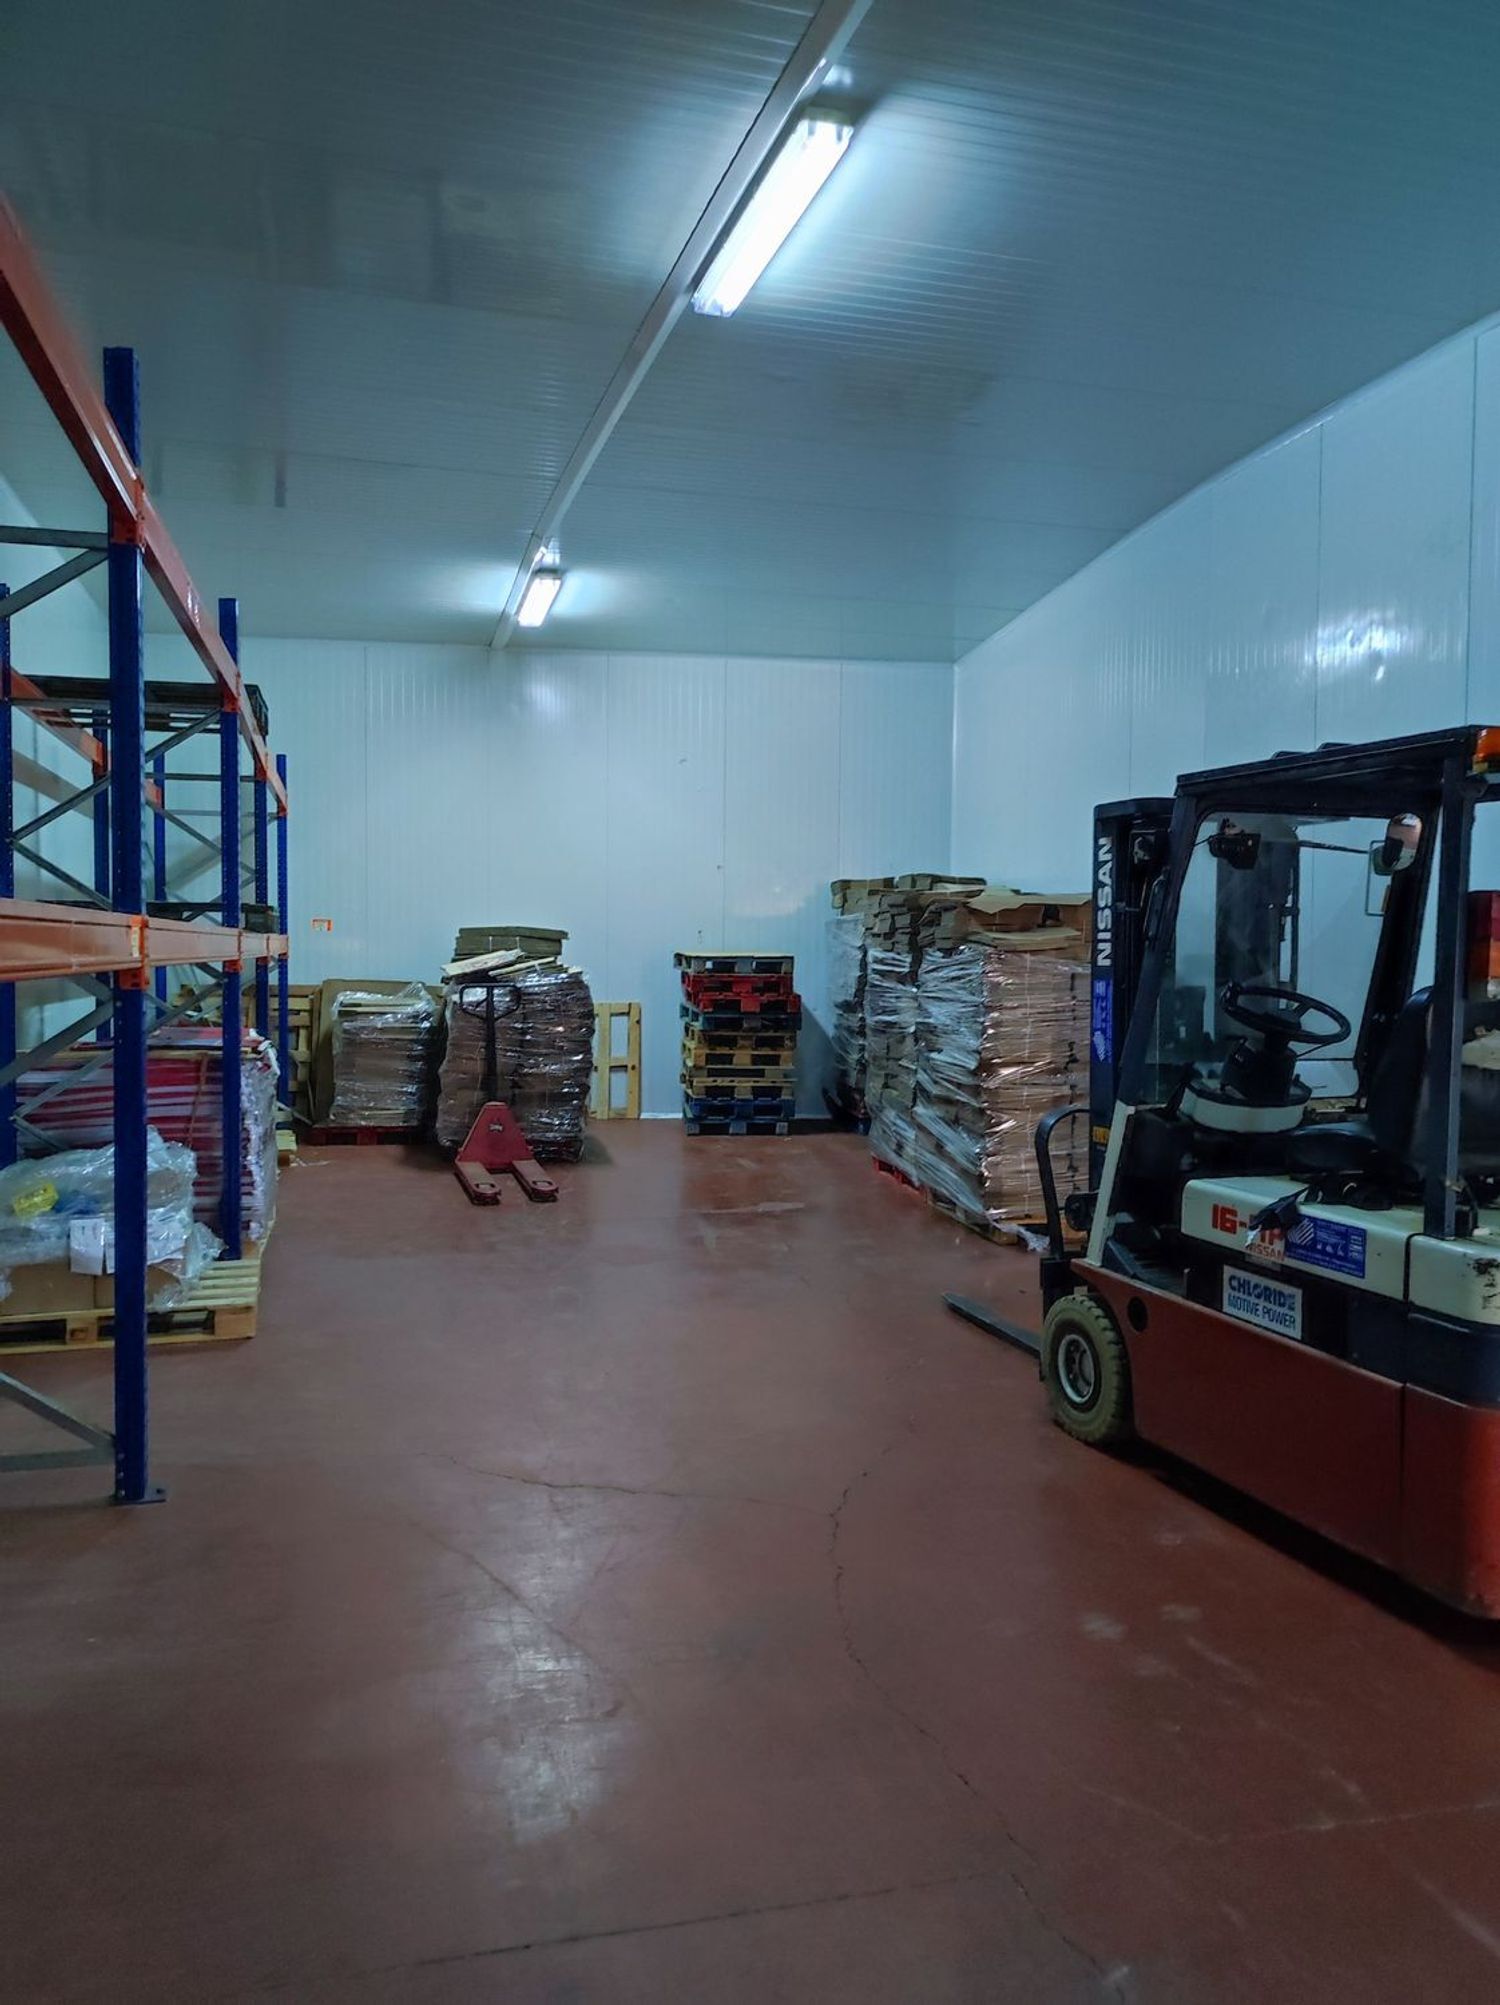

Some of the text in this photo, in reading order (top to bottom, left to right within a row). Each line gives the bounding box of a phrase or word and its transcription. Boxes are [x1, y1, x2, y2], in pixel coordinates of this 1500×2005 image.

[1097, 836, 1113, 966] NISSAN
[1212, 1204, 1284, 1246] 16-P
[1228, 1293, 1296, 1331] MOTIVE POWER
